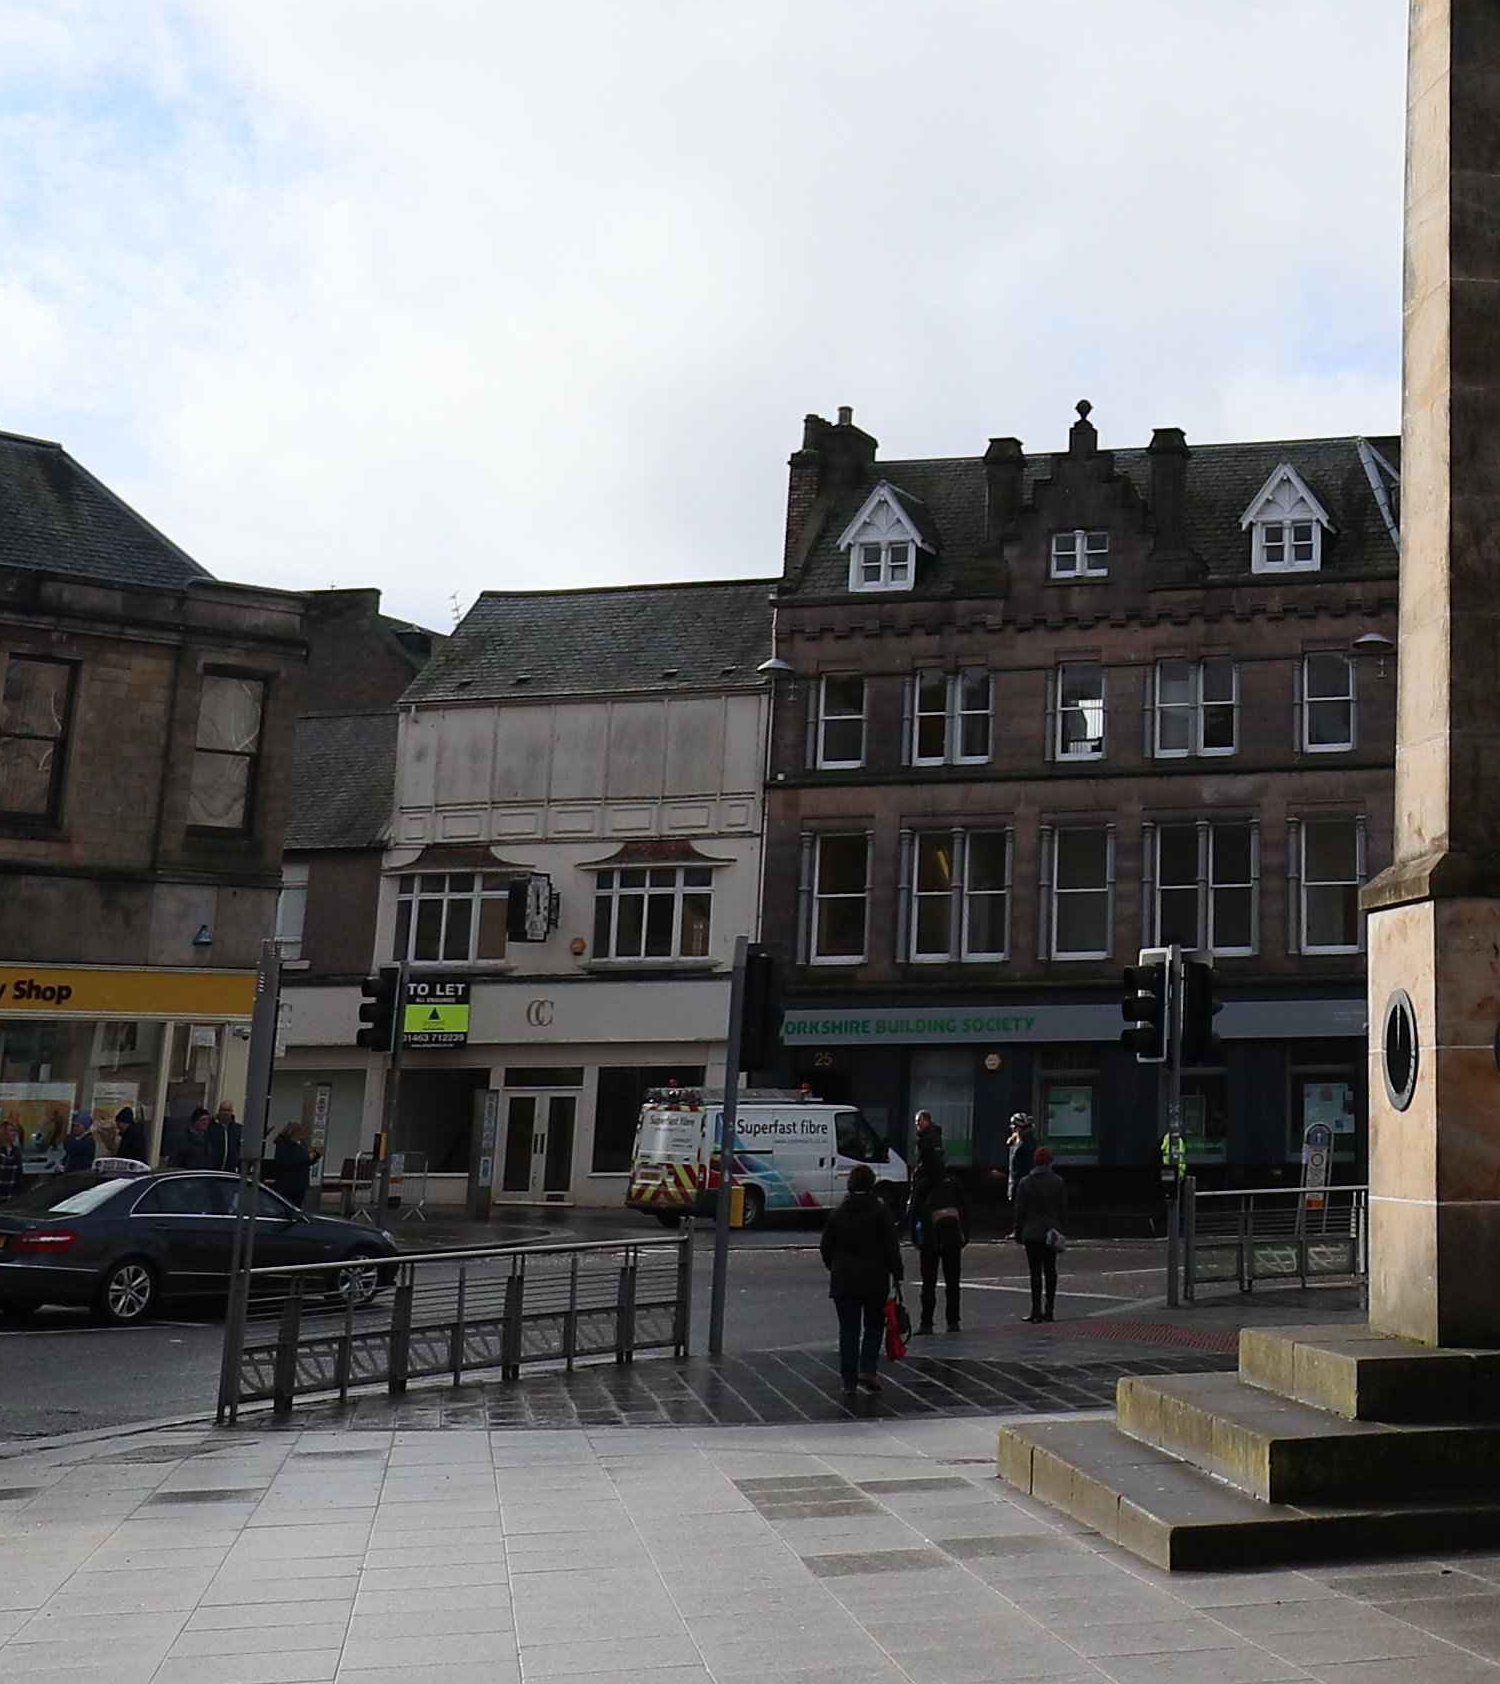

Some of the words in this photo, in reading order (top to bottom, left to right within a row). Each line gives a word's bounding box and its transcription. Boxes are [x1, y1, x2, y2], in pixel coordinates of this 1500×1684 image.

[13, 979, 72, 1005] Shop
[408, 983, 430, 996] TO
[435, 983, 467, 996] LET
[784, 1020, 871, 1035] ORKSHIRE
[875, 1019, 957, 1034] BUILDING
[961, 1017, 1036, 1033] SOCIETY
[814, 1052, 833, 1067] 25
[737, 1119, 797, 1137] Superfast
[801, 1119, 828, 1134] fibre
